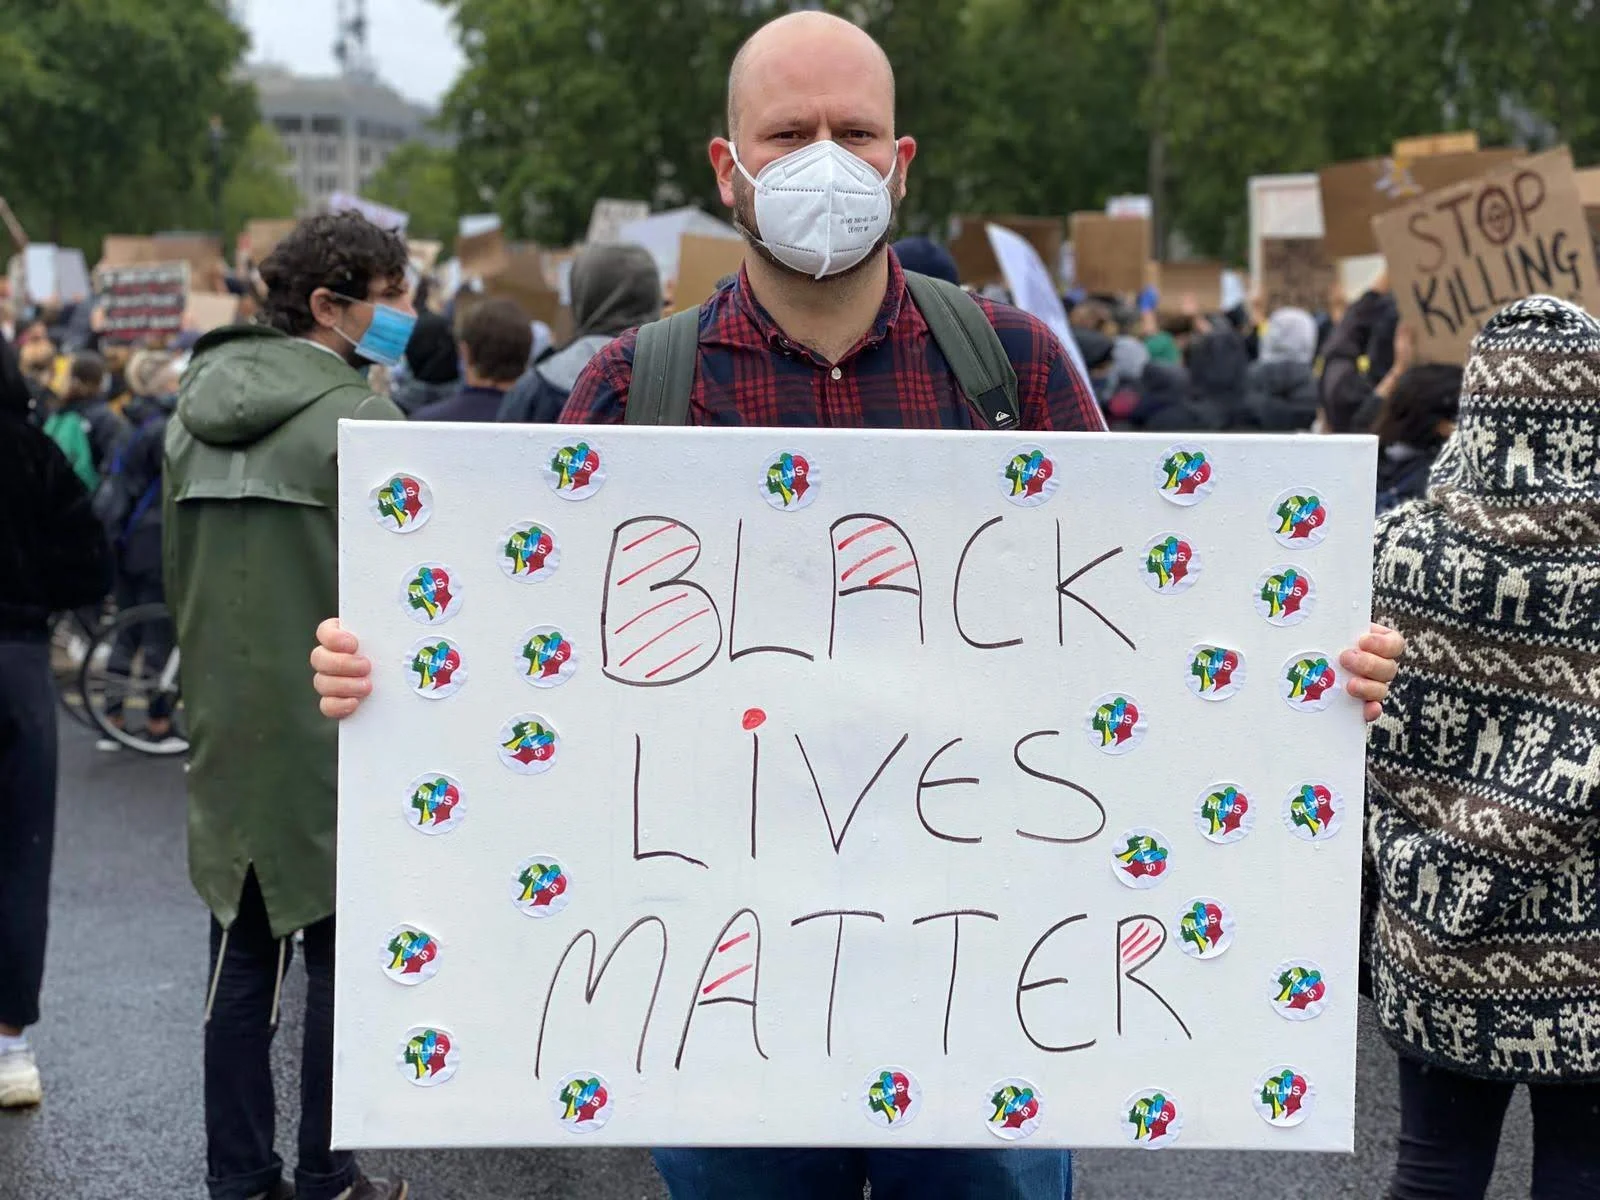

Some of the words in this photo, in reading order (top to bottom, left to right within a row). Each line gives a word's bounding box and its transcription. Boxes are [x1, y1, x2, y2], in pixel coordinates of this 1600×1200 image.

[1408, 169, 1546, 273] STOP
[1412, 231, 1581, 337] KILLING
[601, 513, 1136, 687] BLACK
[534, 907, 1192, 1079] MATTER
